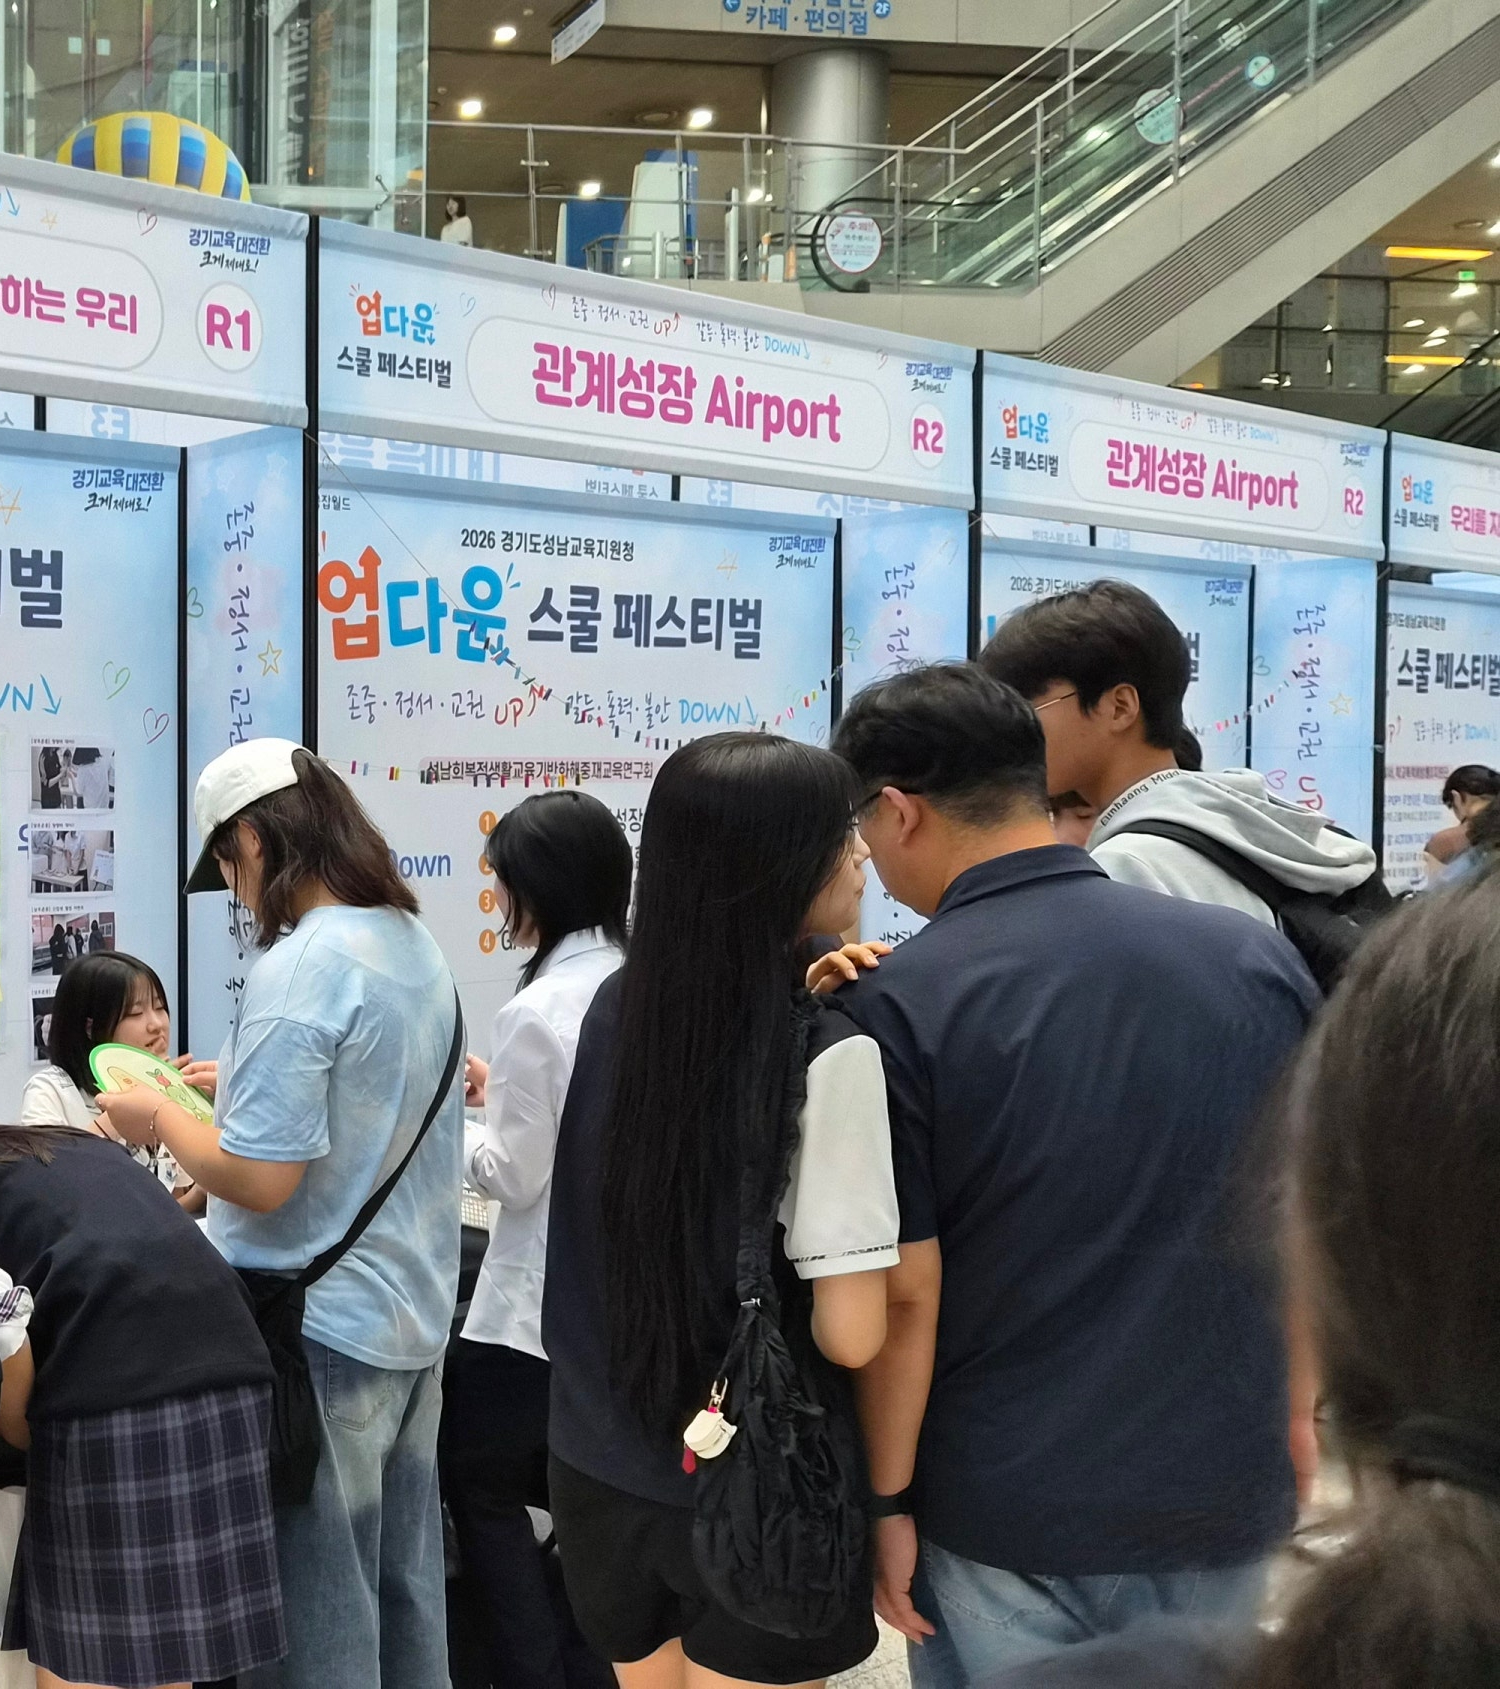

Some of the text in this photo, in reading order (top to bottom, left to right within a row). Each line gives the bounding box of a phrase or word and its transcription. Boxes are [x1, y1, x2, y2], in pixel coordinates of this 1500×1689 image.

[746, 6, 868, 35] 카페 편의점
[875, 4, 890, 15] 2F
[75, 287, 138, 335] 우리
[206, 303, 251, 353] R1
[356, 290, 435, 346] 업다운
[653, 318, 672, 337] UP
[764, 335, 801, 358] DOWN
[337, 346, 451, 389] 스쿨 페스티벌
[532, 342, 842, 443] 관계성장 Airport
[913, 418, 944, 454] R2
[1002, 404, 1049, 443] 업다운
[990, 446, 1059, 477] 스쿨 페스티벌
[1106, 439, 1298, 511] 관계성장 Airport
[1344, 487, 1364, 515] R2
[1450, 505, 1486, 536] 우리를
[461, 528, 635, 562] 2026 경기도성남교육지원청
[1010, 576, 1034, 592] 2026
[318, 545, 763, 664] 업다운 스쿨 페스티벌
[1397, 648, 1500, 697] 스쿨 페스티벌
[494, 698, 524, 728] UP
[679, 697, 741, 725] DOWN
